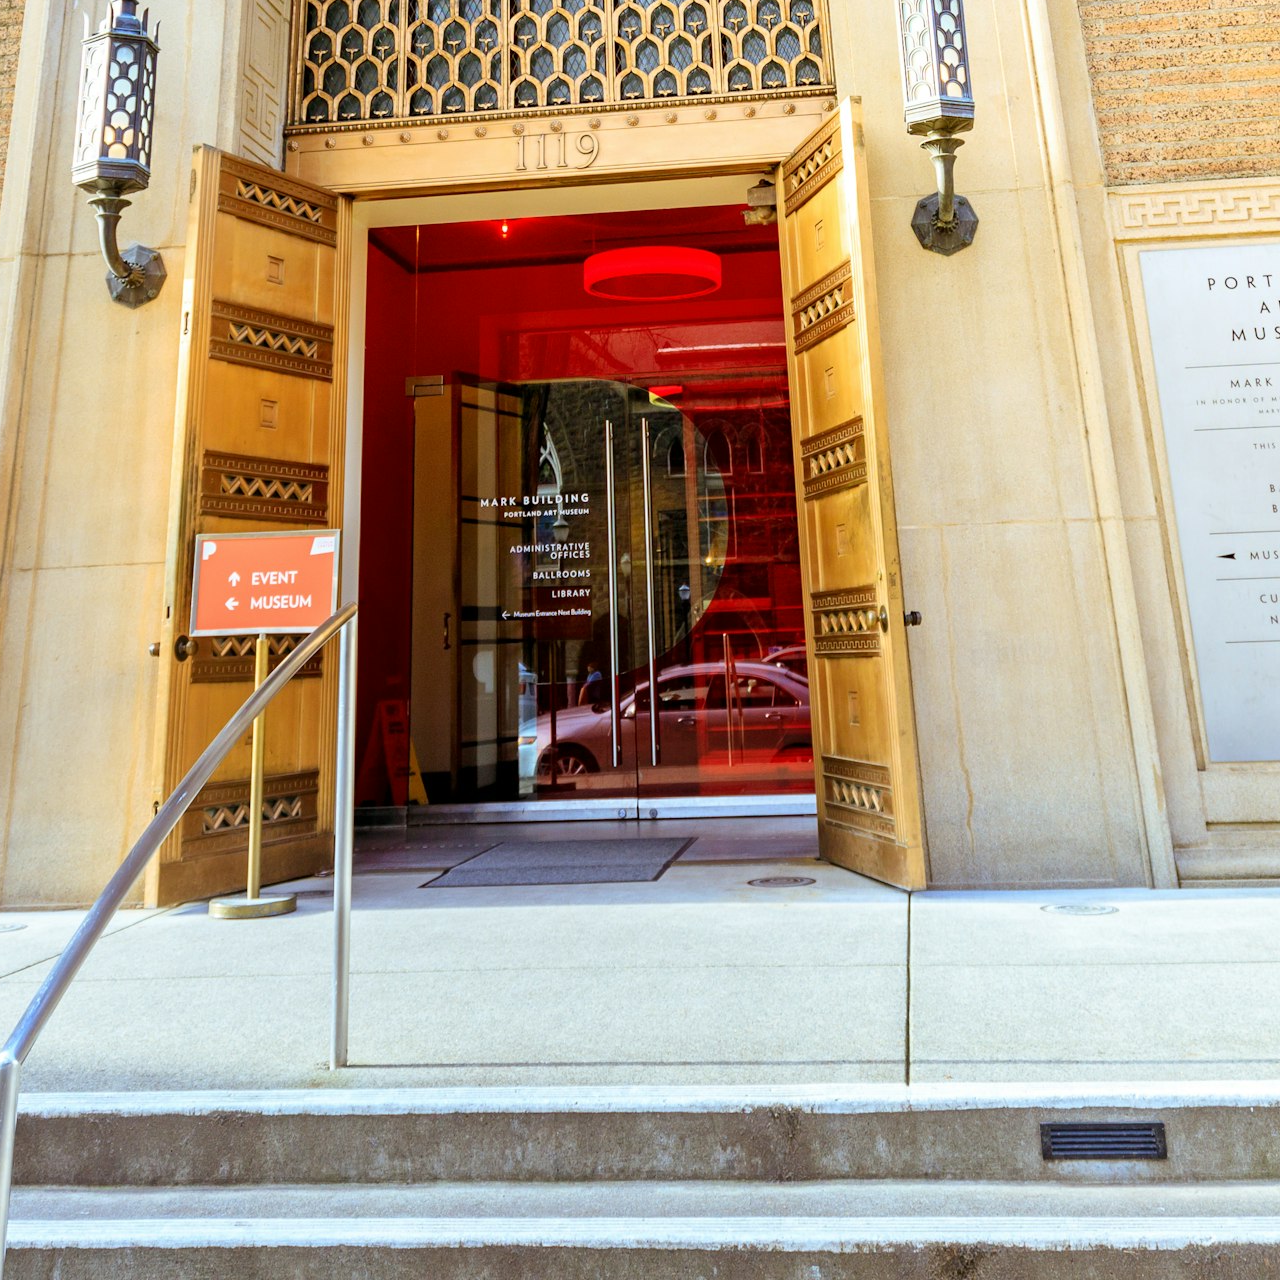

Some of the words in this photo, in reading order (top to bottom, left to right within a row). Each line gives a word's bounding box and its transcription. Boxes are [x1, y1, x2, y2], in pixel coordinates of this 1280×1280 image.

[516, 132, 600, 171] 1119
[1230, 377, 1273, 389] MARK
[1212, 397, 1247, 406] HONOR
[1253, 442, 1276, 450] THIS
[480, 497, 516, 507] MARK
[523, 494, 589, 505] BUILDING
[543, 509, 558, 517] ART
[559, 508, 589, 516] MUSEUM
[510, 543, 589, 553] ADMINISTRATIVE
[550, 551, 590, 559] OFFICES
[251, 571, 297, 585] EVENT
[533, 570, 590, 579] BALLROOMS
[552, 589, 590, 598] LIBRARY
[250, 595, 311, 609] MUSEUM
